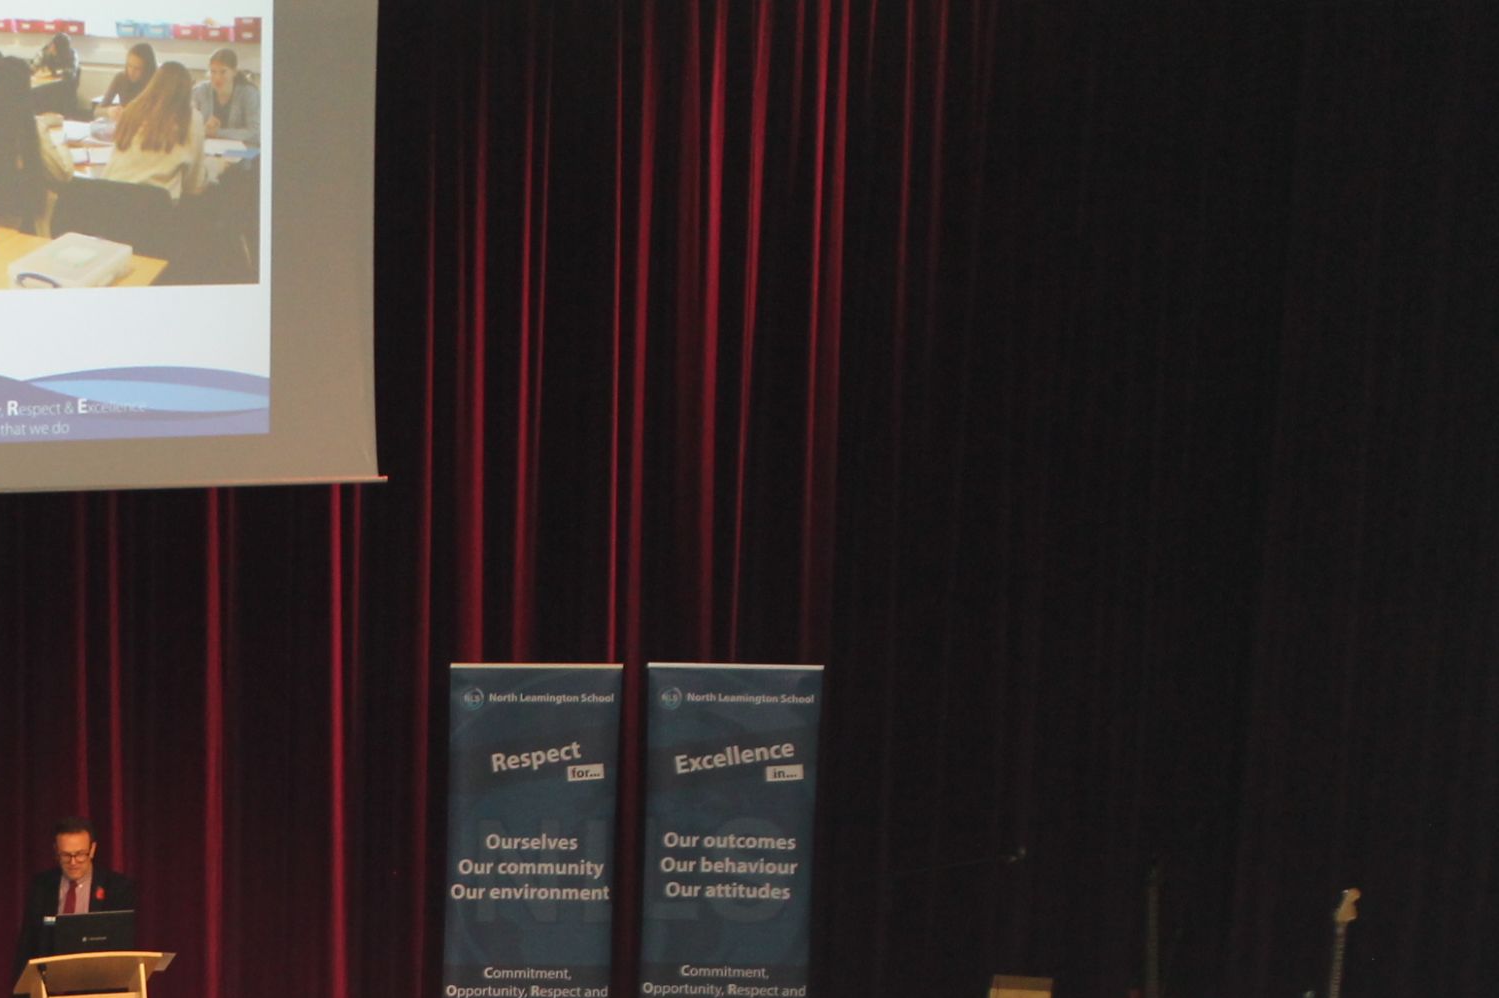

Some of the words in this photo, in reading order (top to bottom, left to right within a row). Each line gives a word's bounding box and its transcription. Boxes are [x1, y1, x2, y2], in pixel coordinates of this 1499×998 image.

[7, 400, 61, 418] Respect
[64, 401, 74, 415] &
[77, 398, 146, 414] Excellence
[0, 422, 26, 436] that
[30, 425, 49, 434] we
[52, 422, 69, 434] do
[489, 692, 517, 702] North
[520, 692, 579, 705] Leamington
[581, 692, 614, 703] School
[687, 692, 716, 702] North
[718, 692, 778, 705] Leamington
[781, 693, 815, 704] School
[491, 741, 582, 773] Respect
[675, 743, 795, 774] Excellence
[571, 767, 600, 778] for...
[773, 768, 797, 779] in...
[486, 833, 578, 850] Ourselves
[664, 831, 699, 848] Our
[703, 833, 796, 850] outcomes
[458, 858, 494, 875] Our
[498, 859, 604, 879] community
[660, 856, 696, 873] Our
[700, 856, 798, 875] behaviour
[451, 884, 485, 899] Our
[490, 884, 610, 900] environment
[665, 882, 701, 897] Our
[705, 883, 791, 899] attitudes
[484, 966, 572, 980] Commitment,
[680, 964, 769, 979] Commitment,
[446, 985, 528, 998] Opportunity,
[584, 985, 608, 998] and
[642, 982, 725, 997] Opportunity,
[727, 983, 778, 998] Respect
[782, 985, 807, 997] and
